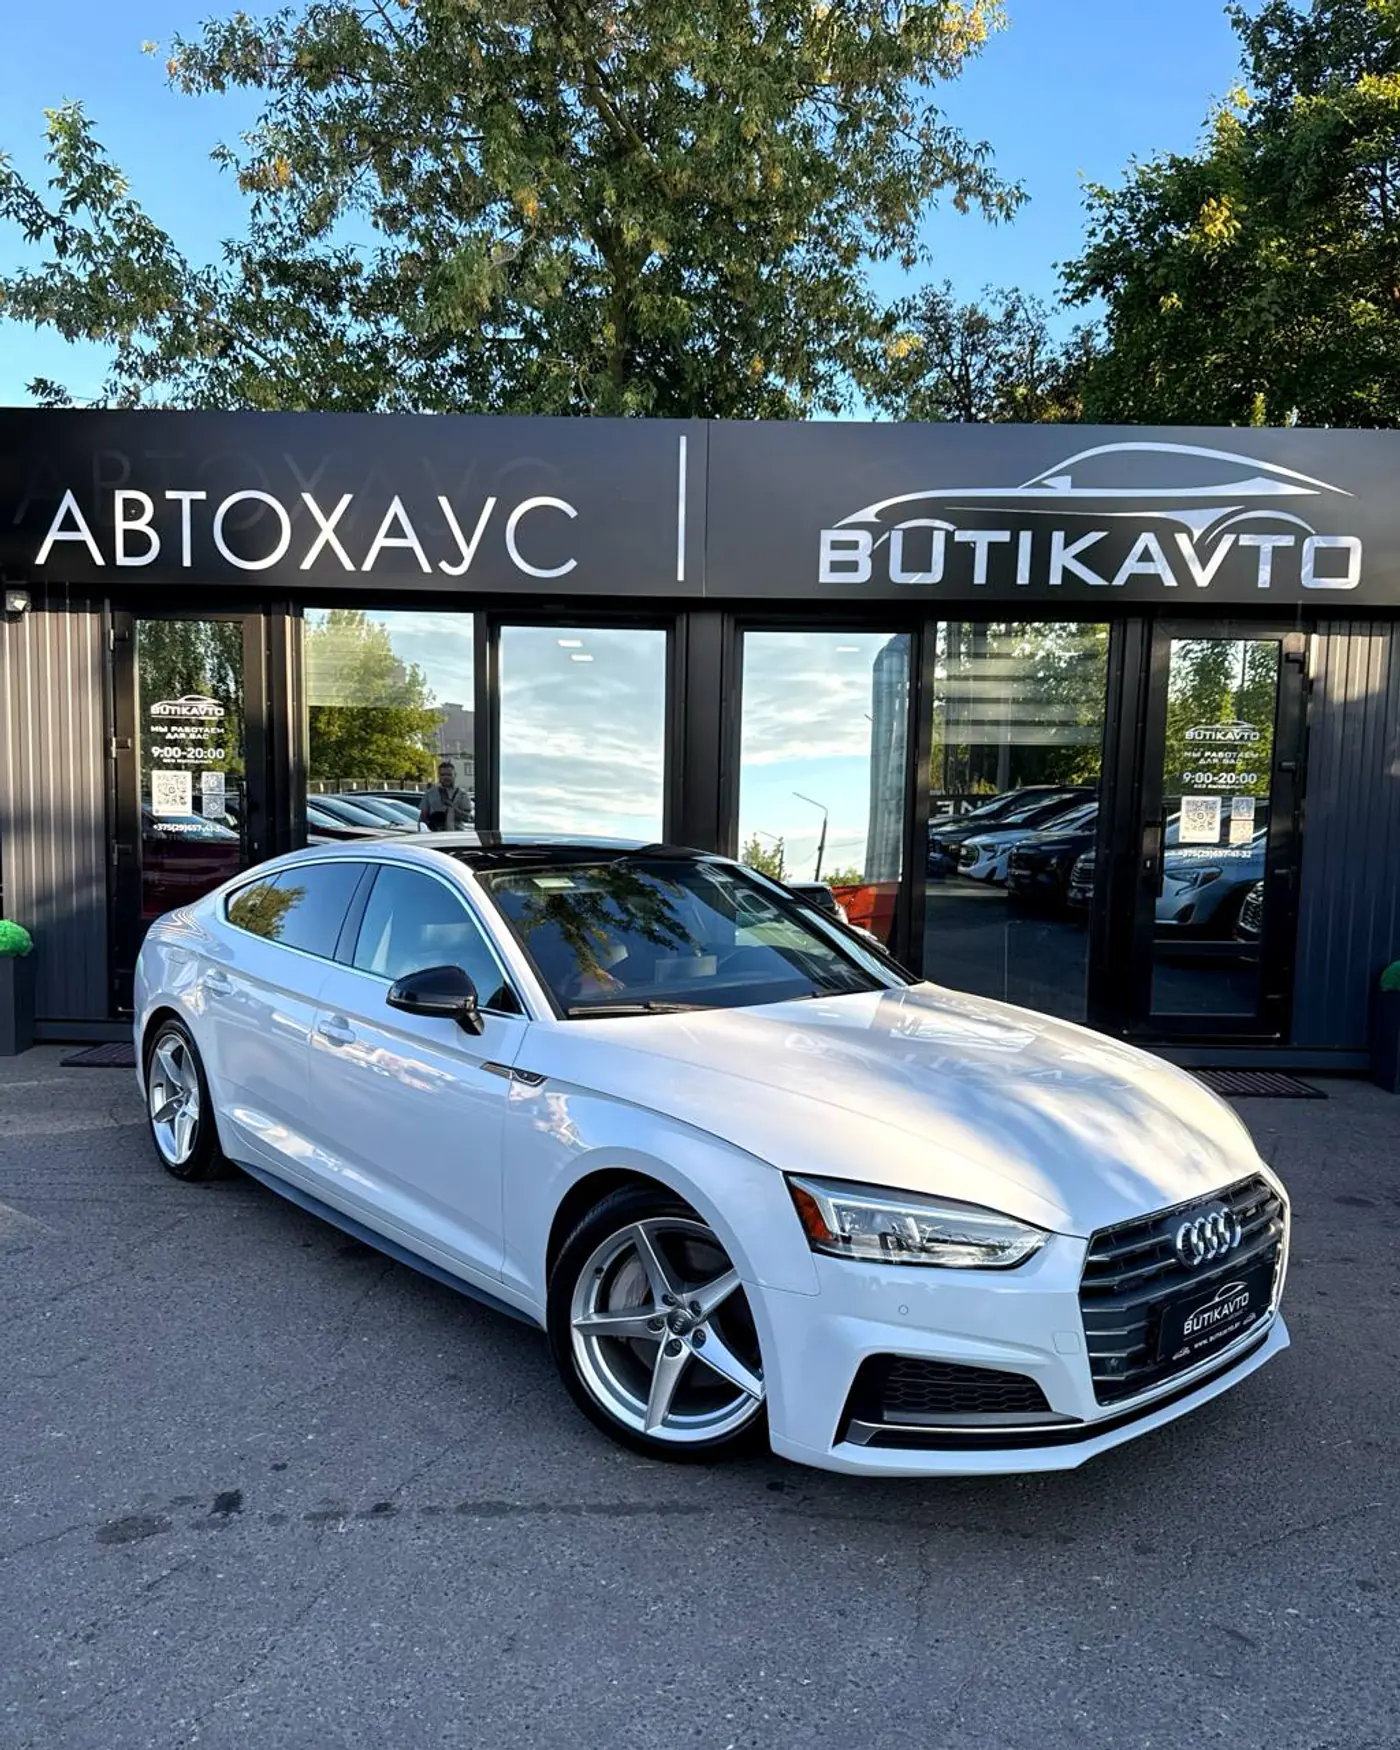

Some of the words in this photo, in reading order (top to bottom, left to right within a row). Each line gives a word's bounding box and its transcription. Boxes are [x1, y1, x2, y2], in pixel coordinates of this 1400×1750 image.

[35, 489, 578, 578] АВТОХАУС
[819, 529, 1362, 590] BUTIKAVTO
[151, 705, 225, 716] BUTIKAVTO
[1185, 730, 1260, 740] BUTIKAVTO
[151, 746, 225, 759] 9:00-20:00
[1183, 772, 1257, 784] 9:00-20:00
[1183, 1292, 1250, 1335] BUTIKAVTO
